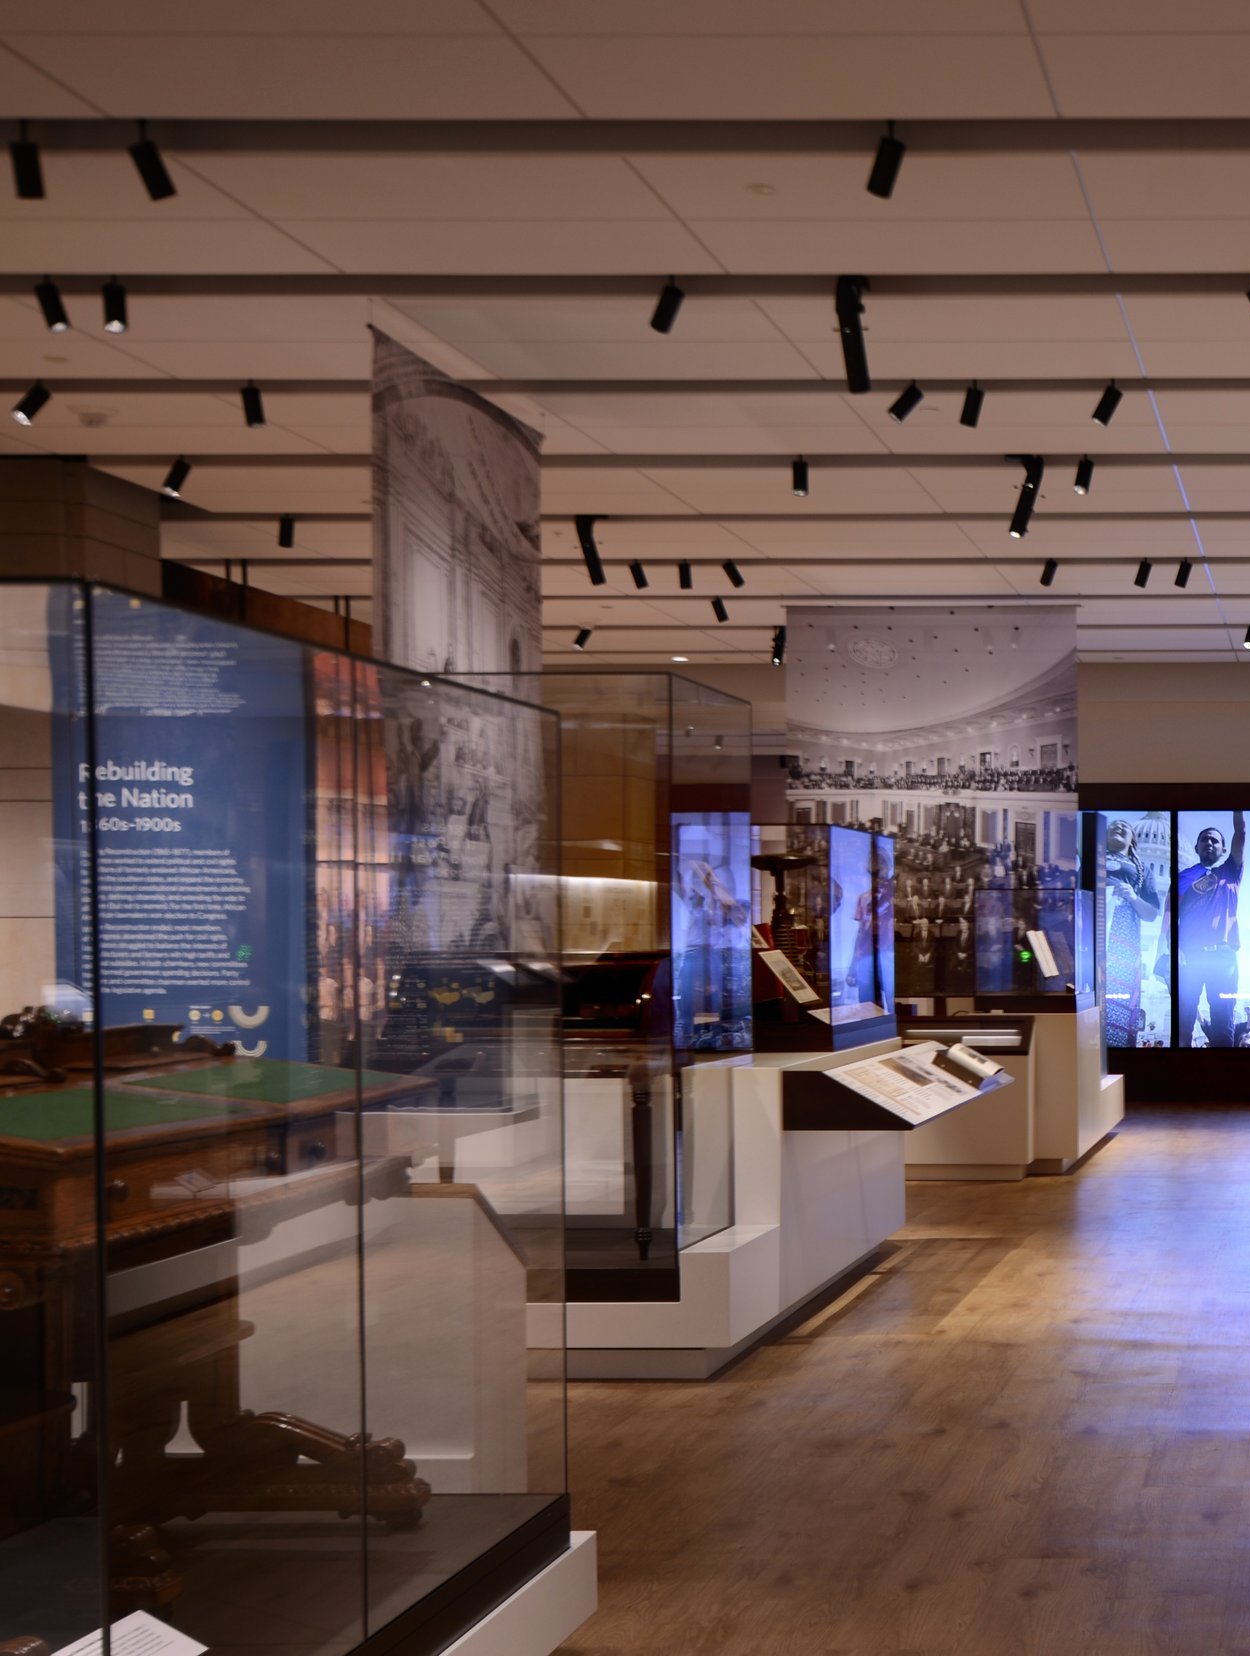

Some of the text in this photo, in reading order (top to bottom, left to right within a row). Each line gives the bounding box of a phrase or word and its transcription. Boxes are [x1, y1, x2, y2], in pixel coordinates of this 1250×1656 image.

[79, 760, 194, 786] Rebuilding
[121, 786, 194, 808] Nation
[80, 817, 182, 832] 160s-1900s
